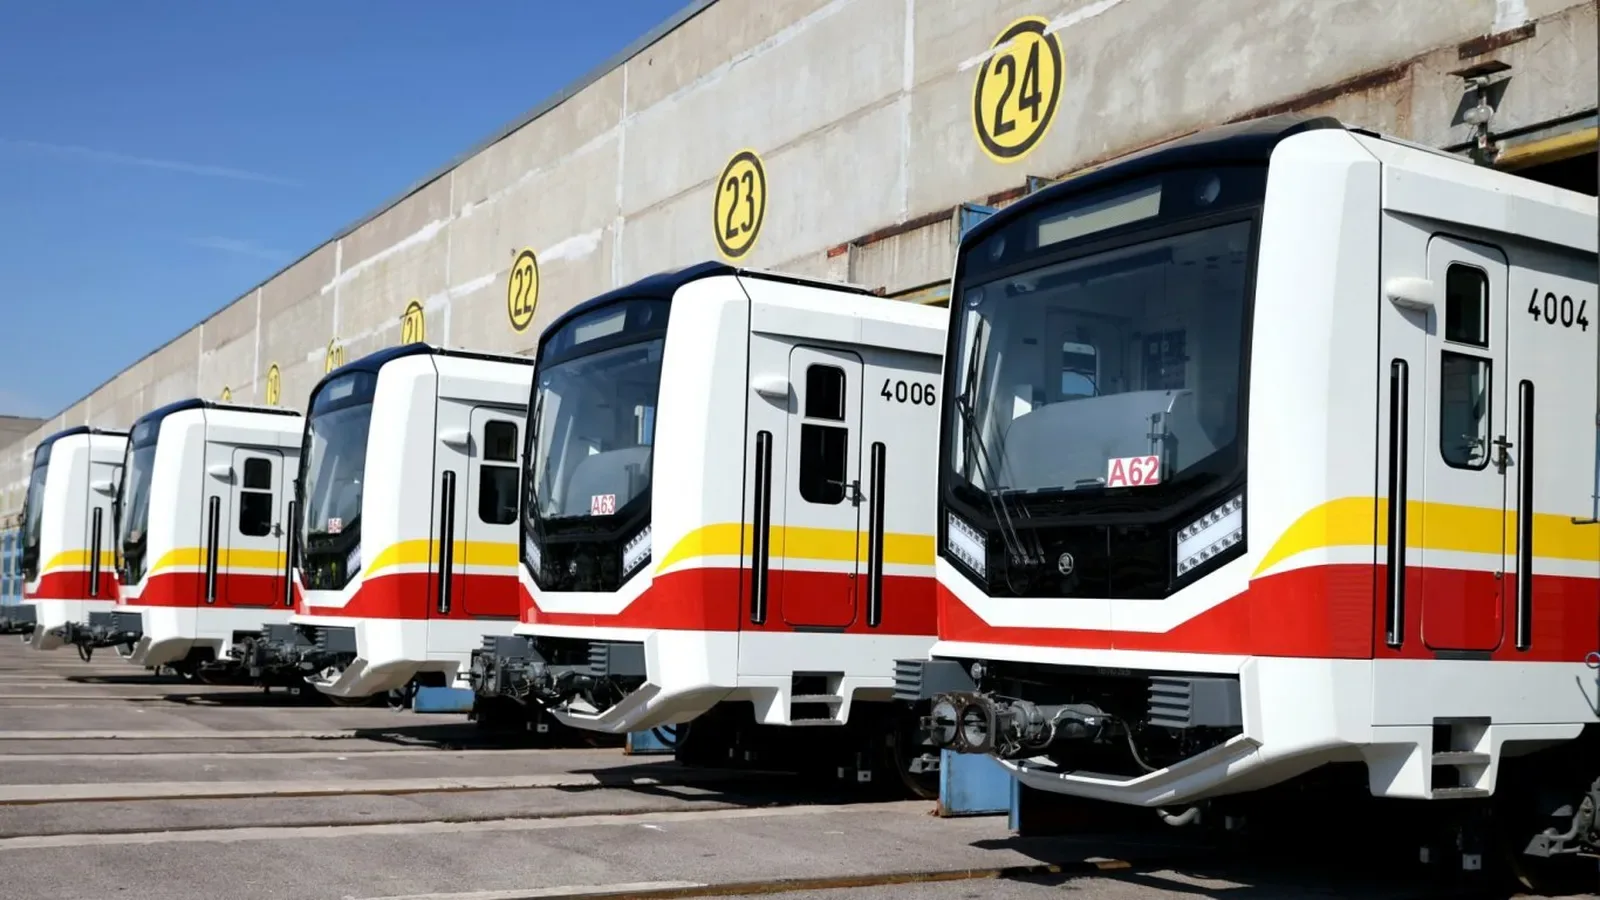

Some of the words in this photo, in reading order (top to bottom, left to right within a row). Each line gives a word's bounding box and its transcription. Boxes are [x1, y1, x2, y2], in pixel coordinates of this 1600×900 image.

[993, 39, 1042, 138] 24
[725, 169, 755, 240] 23
[513, 264, 533, 317] 22
[1528, 287, 1589, 332] 4004
[880, 378, 936, 407] 4006
[1108, 456, 1159, 487] A62
[592, 495, 615, 514] A63
